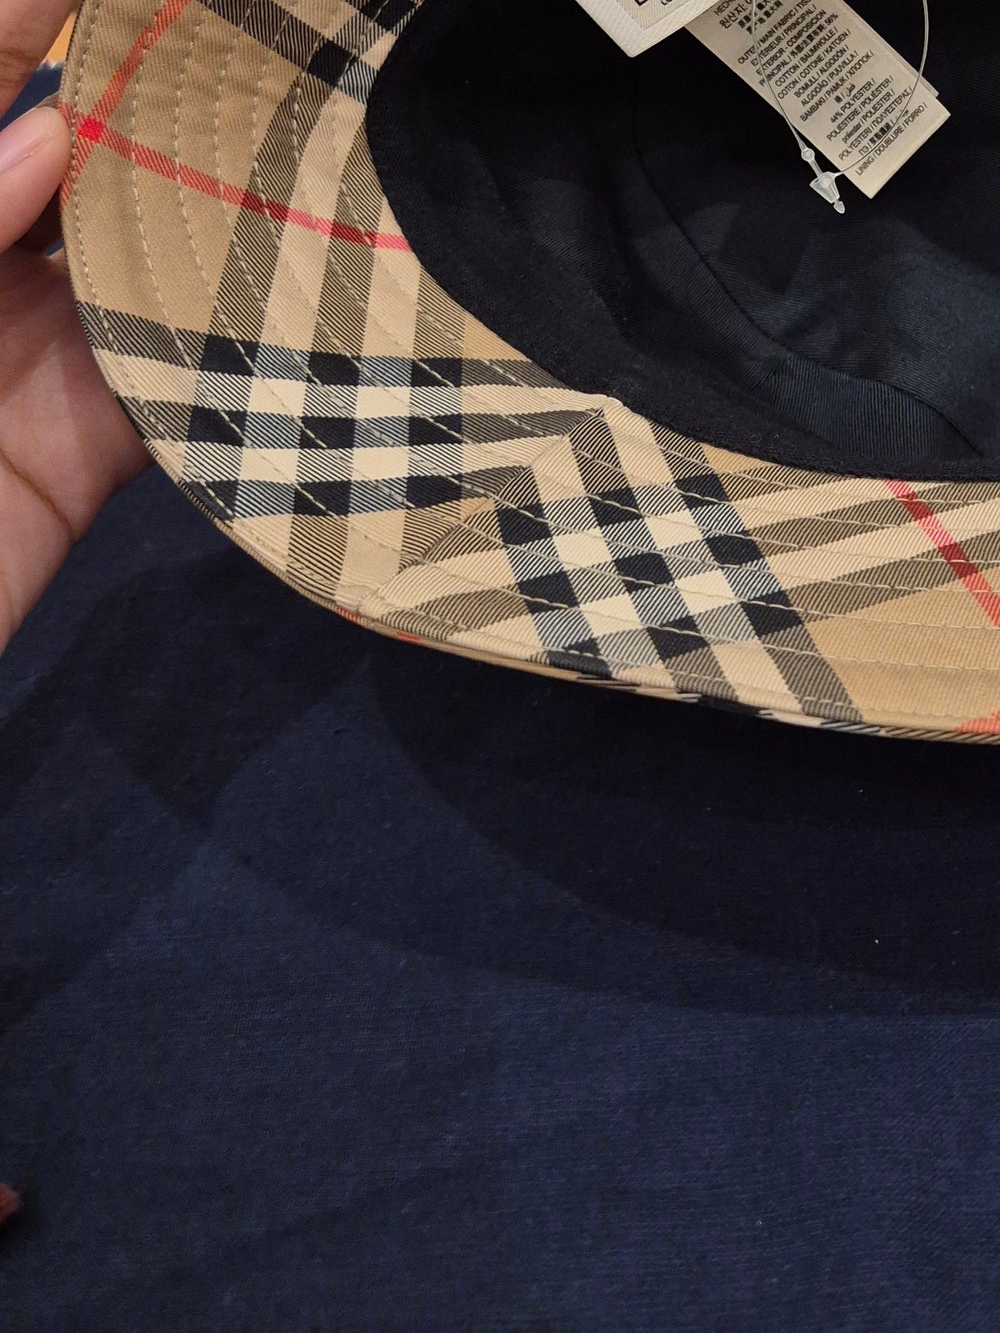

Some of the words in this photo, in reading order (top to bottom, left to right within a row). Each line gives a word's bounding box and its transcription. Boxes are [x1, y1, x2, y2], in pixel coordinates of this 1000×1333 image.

[719, 3, 748, 29] 원산지:
[759, 28, 776, 44] MAIN
[773, 9, 797, 31] FABRIC
[783, 8, 815, 36] PRINCIPAL
[774, 62, 801, 87] COTTON
[799, 28, 837, 64] BAUMWOLLE
[777, 78, 800, 100] COTON
[799, 53, 825, 79] COTONE
[823, 31, 849, 55] KATOEN
[793, 75, 820, 99] BOMULL
[818, 46, 847, 76] ALGODÓN
[800, 79, 829, 107] ALGODÃO
[827, 53, 857, 80] PUUVILLA
[830, 111, 844, 123] 44%
[840, 80, 874, 114] POLYESTER
[861, 91, 894, 122] POLIESTER
[826, 107, 862, 142] POLIESTERE
[838, 126, 873, 161] POLYESTERI
[855, 155, 876, 176] LINING
[871, 124, 905, 156] DOUBLURE
[903, 104, 925, 127] FORRO
